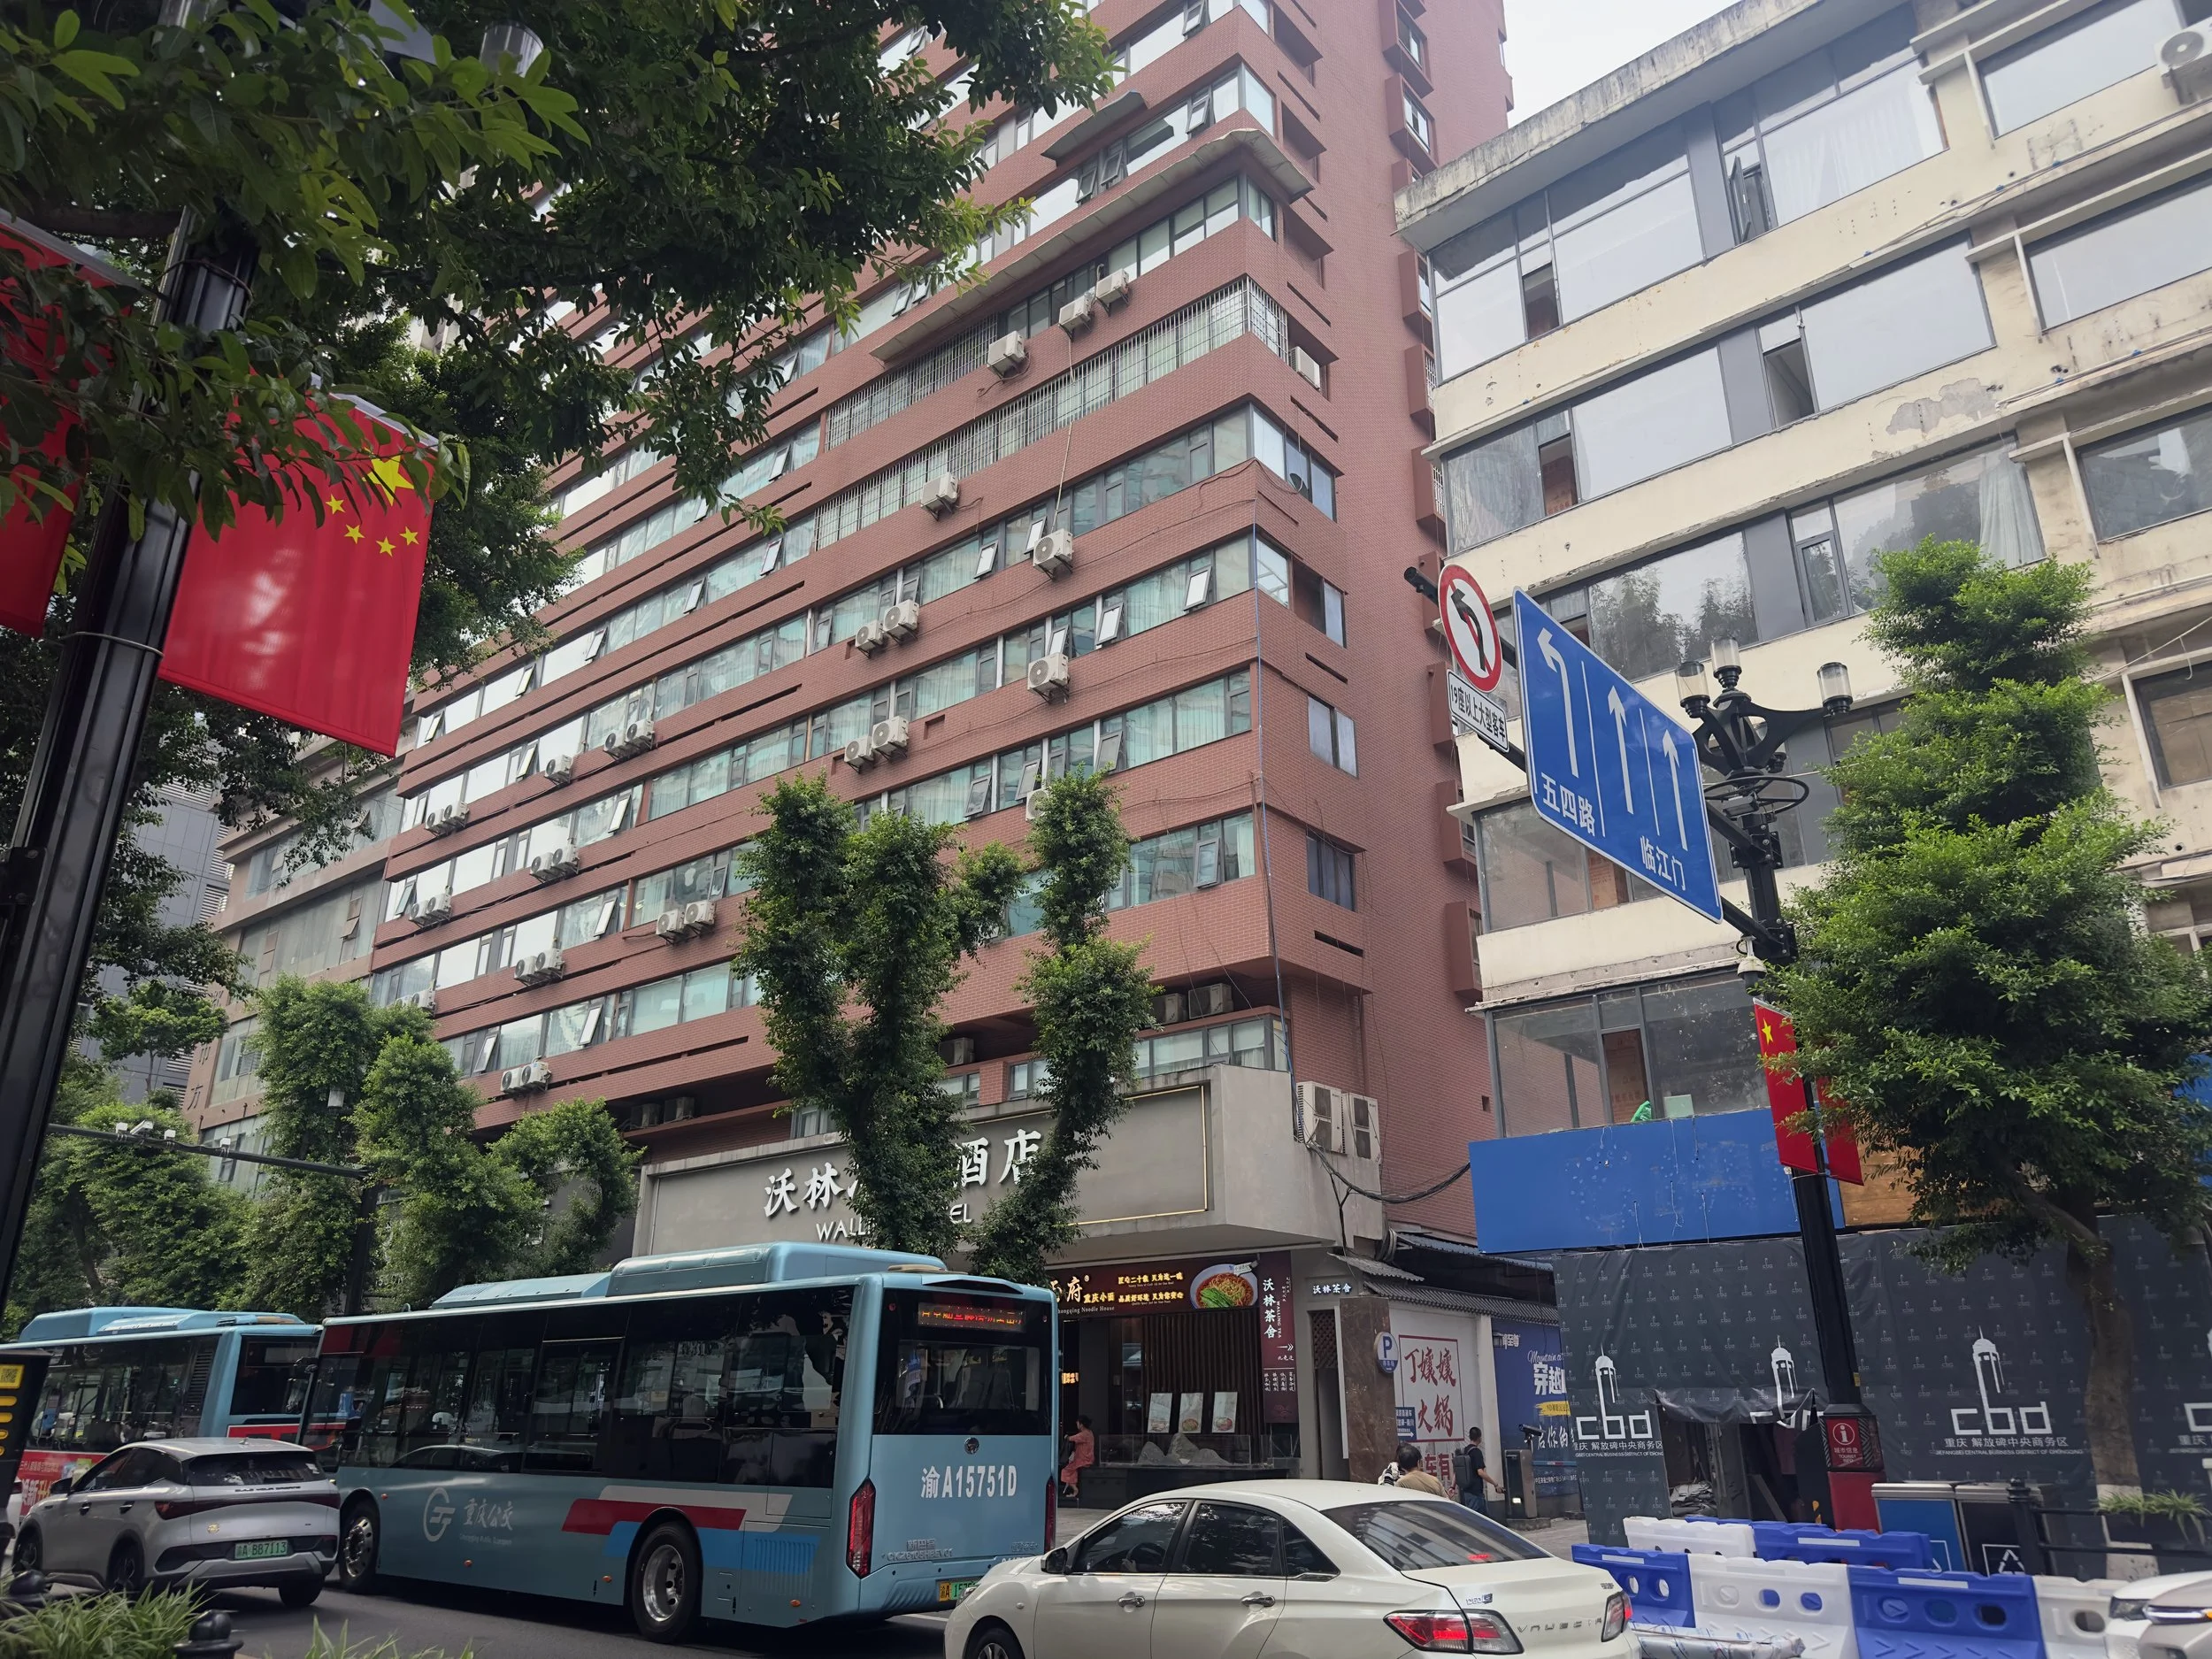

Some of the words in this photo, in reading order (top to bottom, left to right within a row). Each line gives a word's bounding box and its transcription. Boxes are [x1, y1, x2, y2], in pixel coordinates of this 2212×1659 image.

[1450, 684, 1506, 741] 19座以上大型客车
[1542, 772, 1596, 838] 五四路
[1640, 835, 1686, 891] 临江门
[764, 1129, 1041, 1217] 沃林酒店
[1083, 1292, 1115, 1304] 重庆小面
[1313, 1283, 1352, 1294] 沃林茶舍
[1099, 1302, 1115, 1311] House
[1263, 1278, 1278, 1339] 沃林茶舍
[1383, 1336, 1393, 1359] P
[1533, 1362, 1567, 1395] 穿越
[1417, 1394, 1454, 1438] 火锅
[1592, 1440, 1663, 1451] 解放碑中央商务区
[1944, 1438, 1968, 1448] 重庆
[1971, 1436, 2069, 1448] 解放碑中央商务区
[921, 1465, 1017, 1498] 渝A15751D
[464, 1497, 513, 1531] 重庆公交
